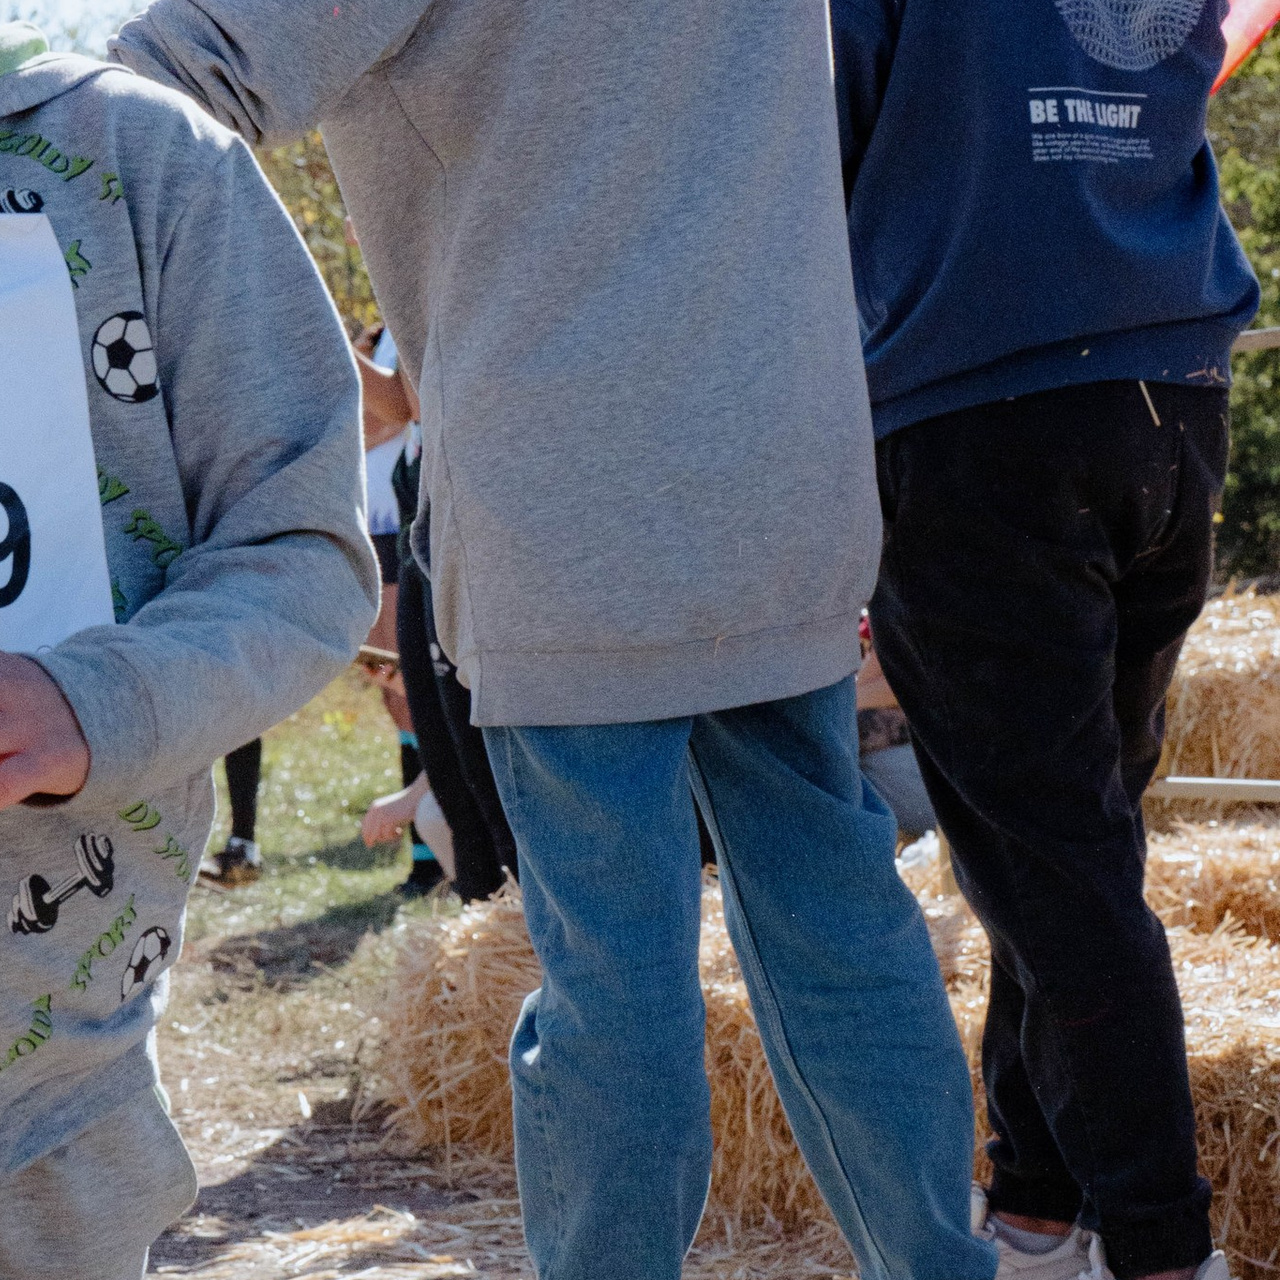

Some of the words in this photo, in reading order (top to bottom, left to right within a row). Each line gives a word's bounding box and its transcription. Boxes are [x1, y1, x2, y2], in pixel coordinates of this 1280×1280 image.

[1029, 99, 1059, 124] BE
[1063, 99, 1095, 123] THE
[1095, 102, 1141, 128] LIGHT
